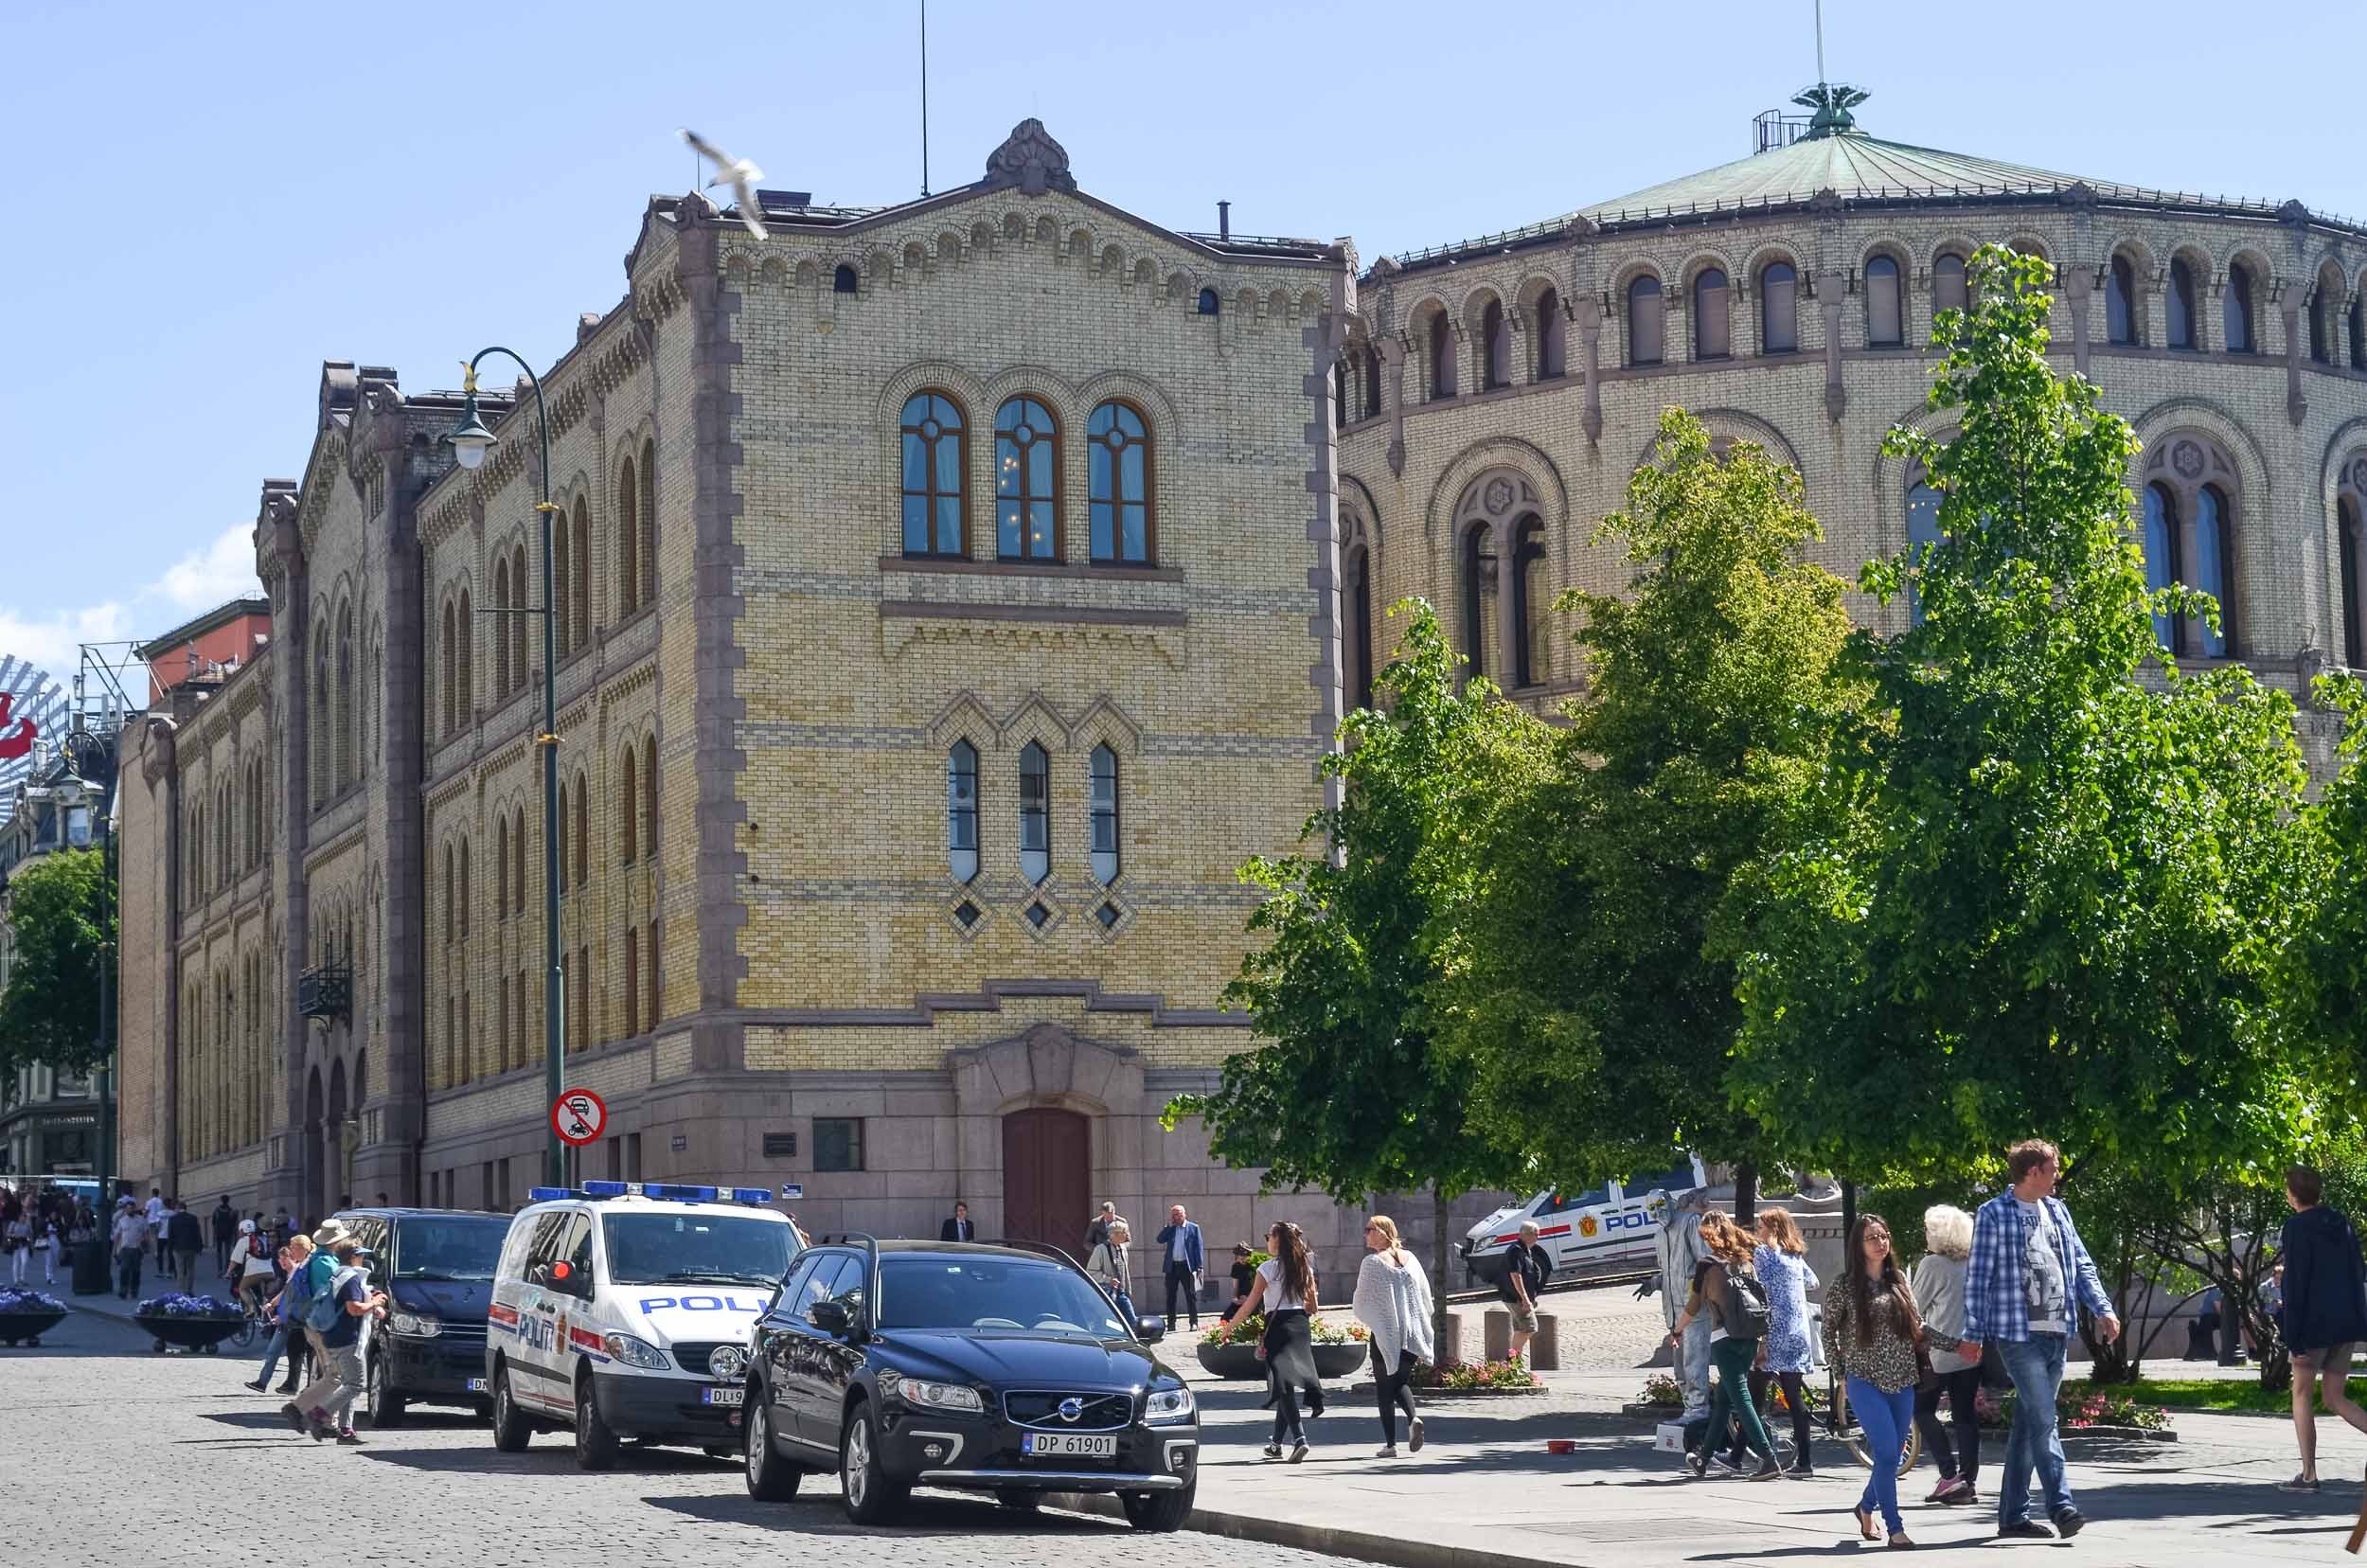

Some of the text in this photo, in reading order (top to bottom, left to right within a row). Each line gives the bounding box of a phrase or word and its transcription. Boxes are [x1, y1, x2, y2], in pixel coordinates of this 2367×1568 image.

[1605, 1211, 1660, 1232] POL
[714, 1390, 729, 1402] DL
[1038, 1435, 1111, 1452] DP 61901
